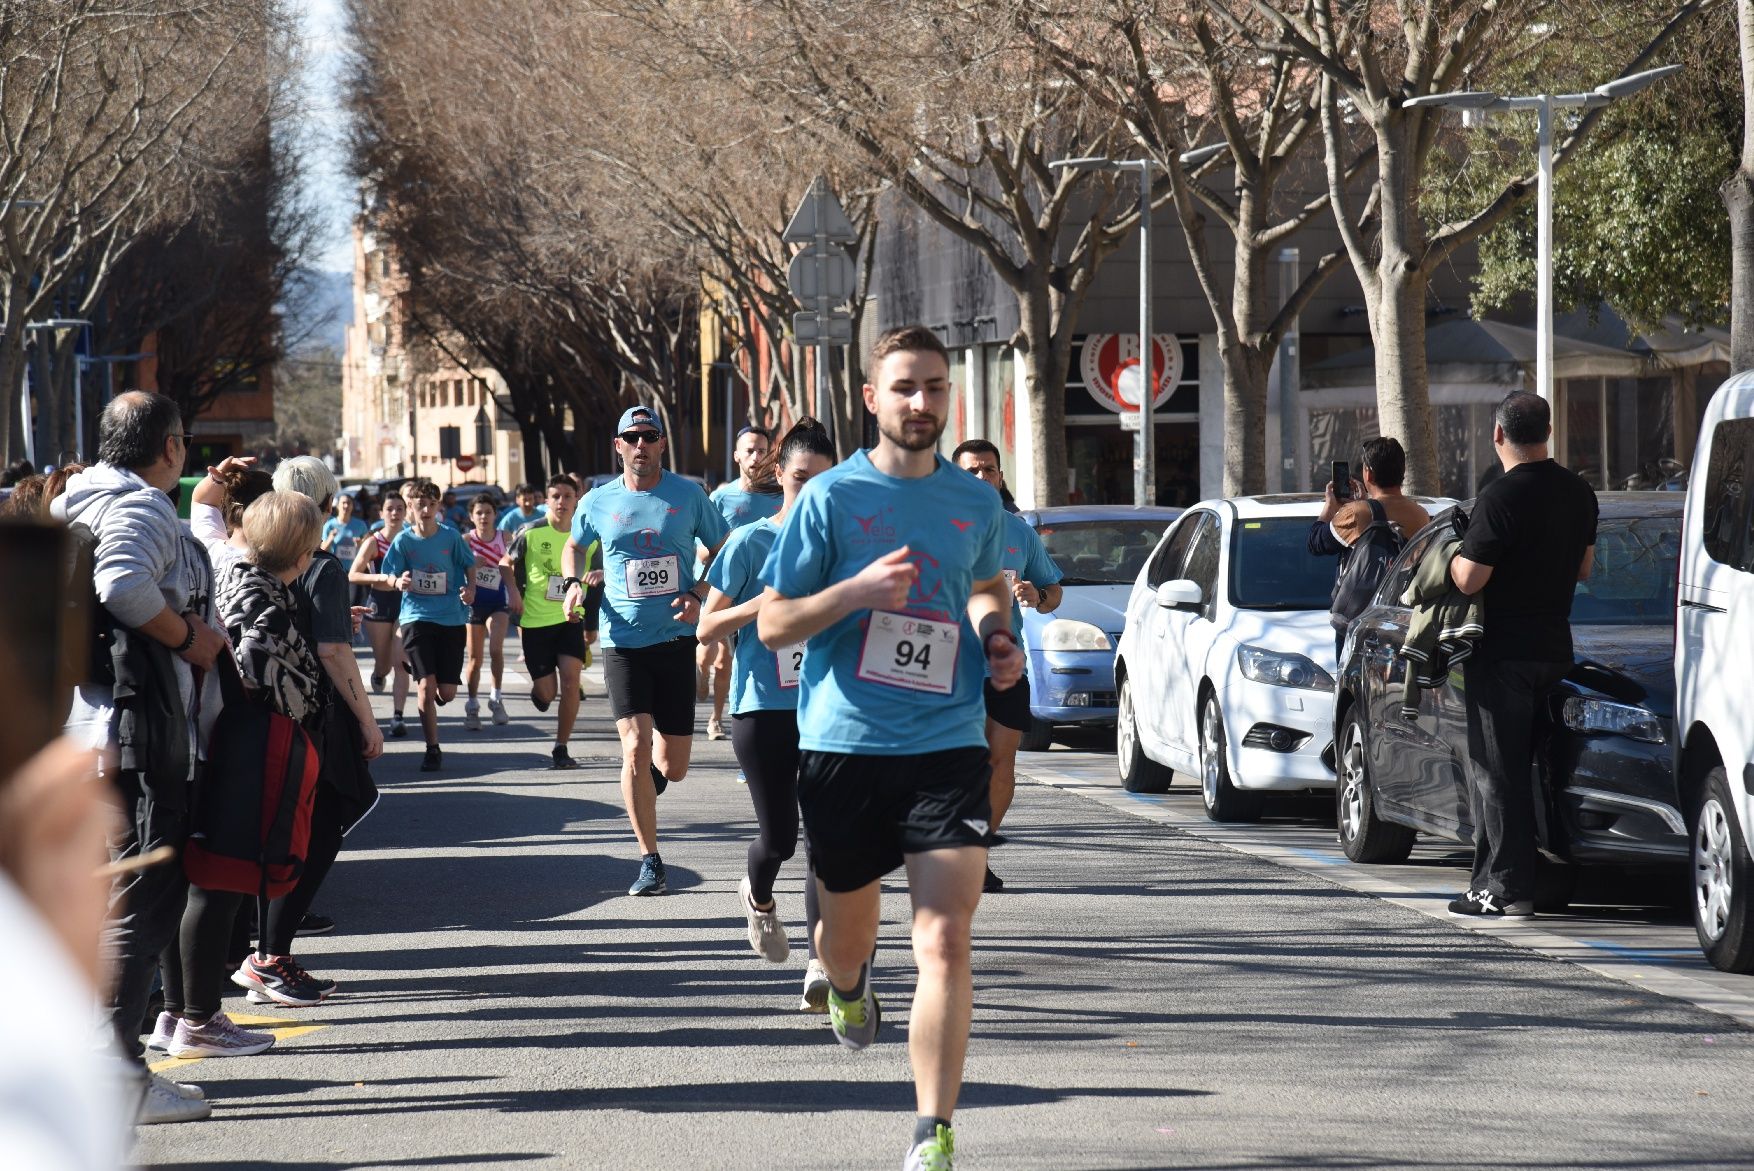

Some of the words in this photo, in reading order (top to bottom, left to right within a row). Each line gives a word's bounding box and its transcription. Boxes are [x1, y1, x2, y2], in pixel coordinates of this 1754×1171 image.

[417, 578, 437, 590] 131
[476, 572, 496, 584] 367
[637, 569, 669, 587] 299
[894, 639, 931, 671] 94
